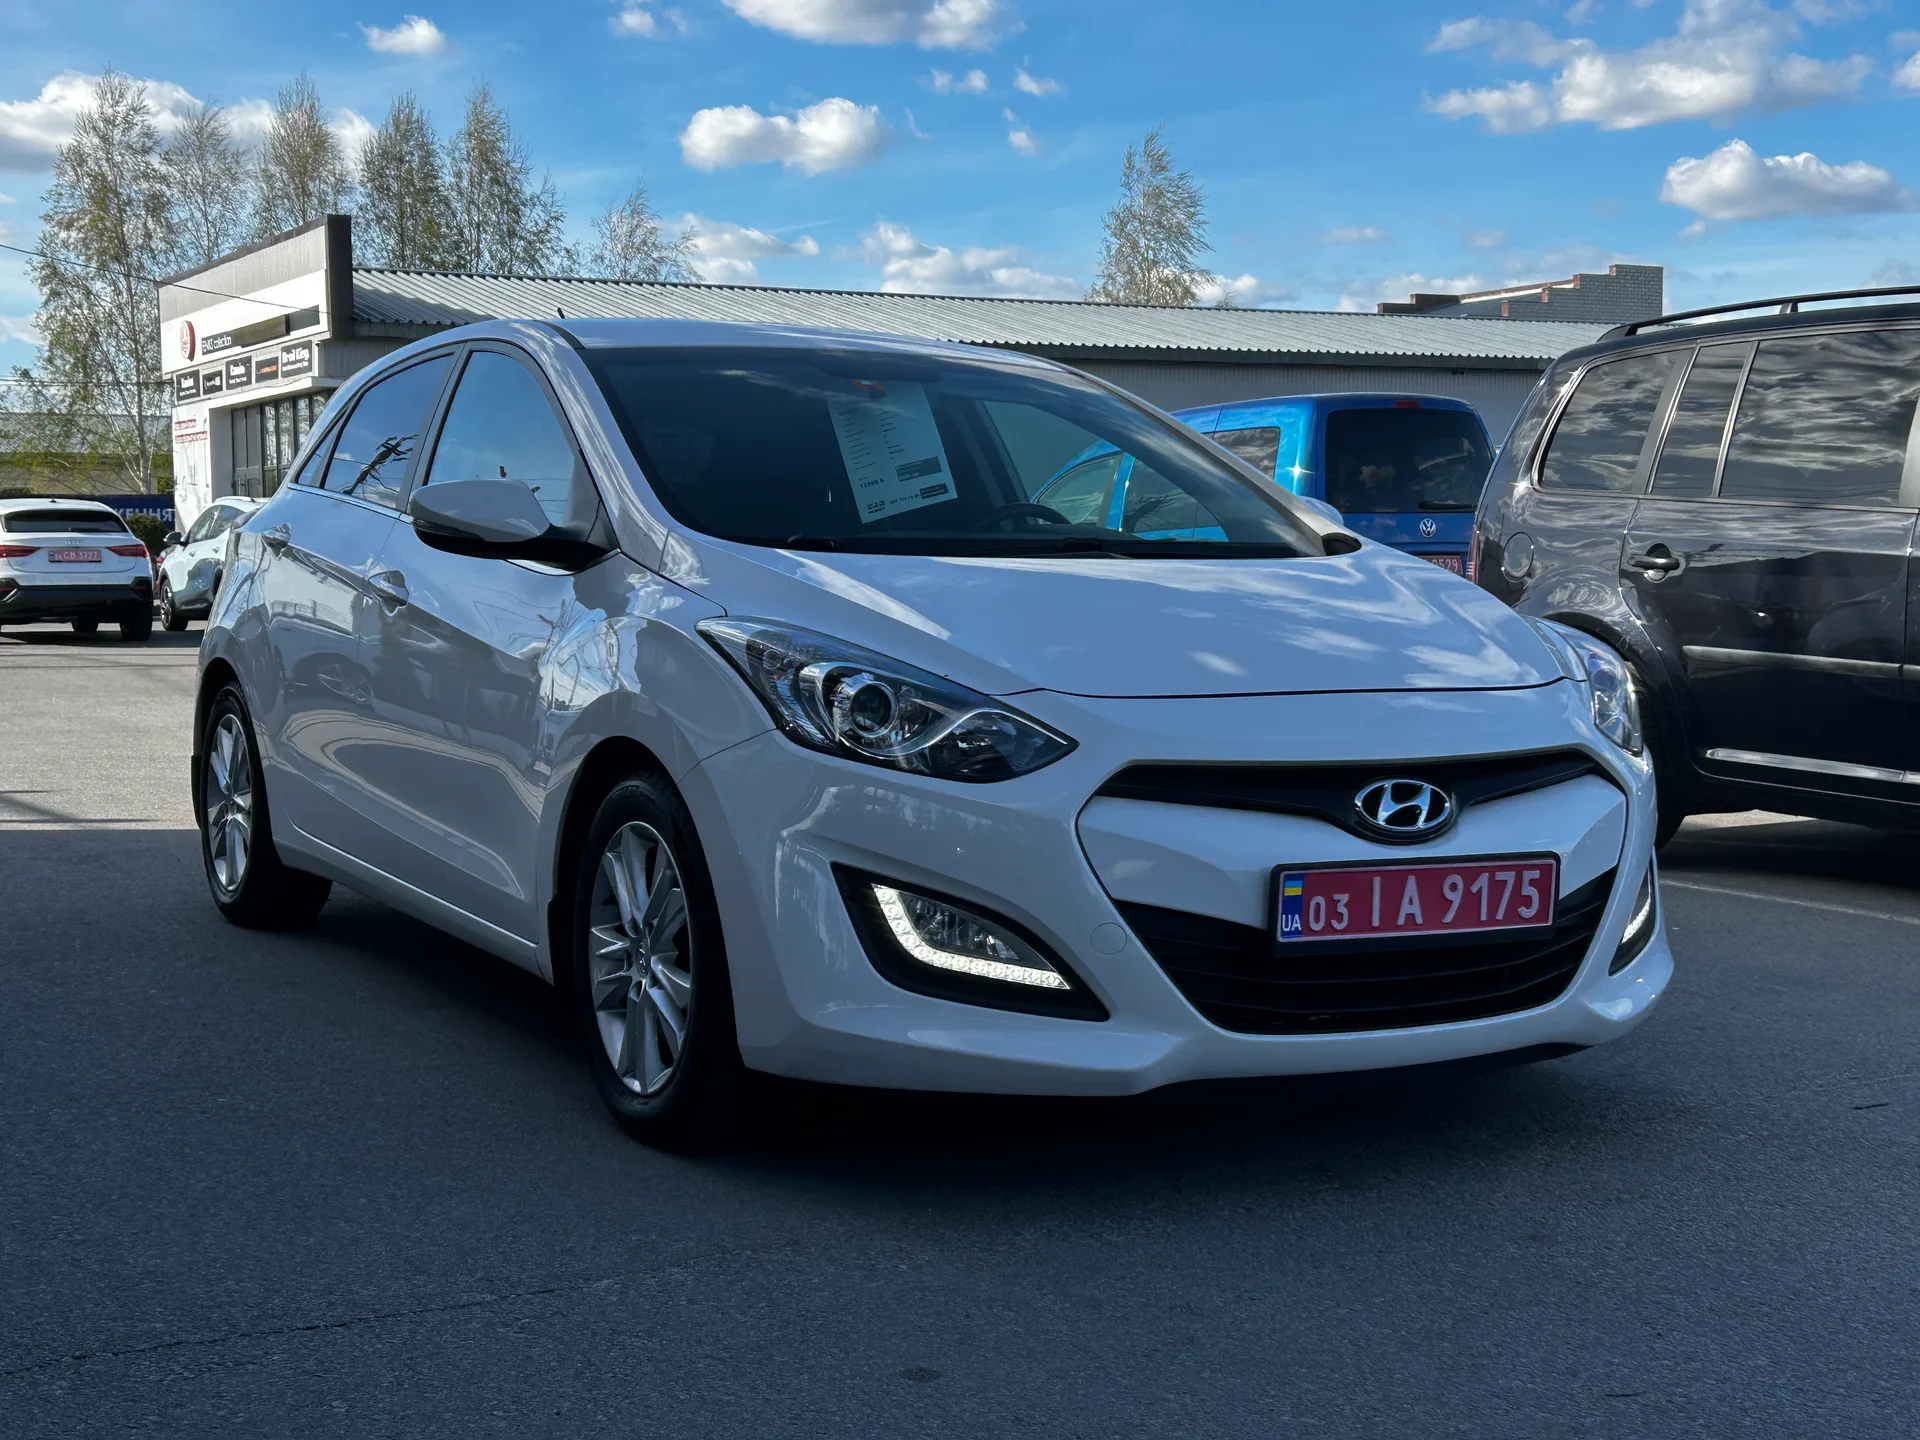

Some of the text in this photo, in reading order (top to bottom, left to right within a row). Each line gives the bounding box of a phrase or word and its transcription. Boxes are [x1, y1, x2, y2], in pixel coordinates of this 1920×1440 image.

[1282, 870, 1540, 932] UA 03 IA 9175
